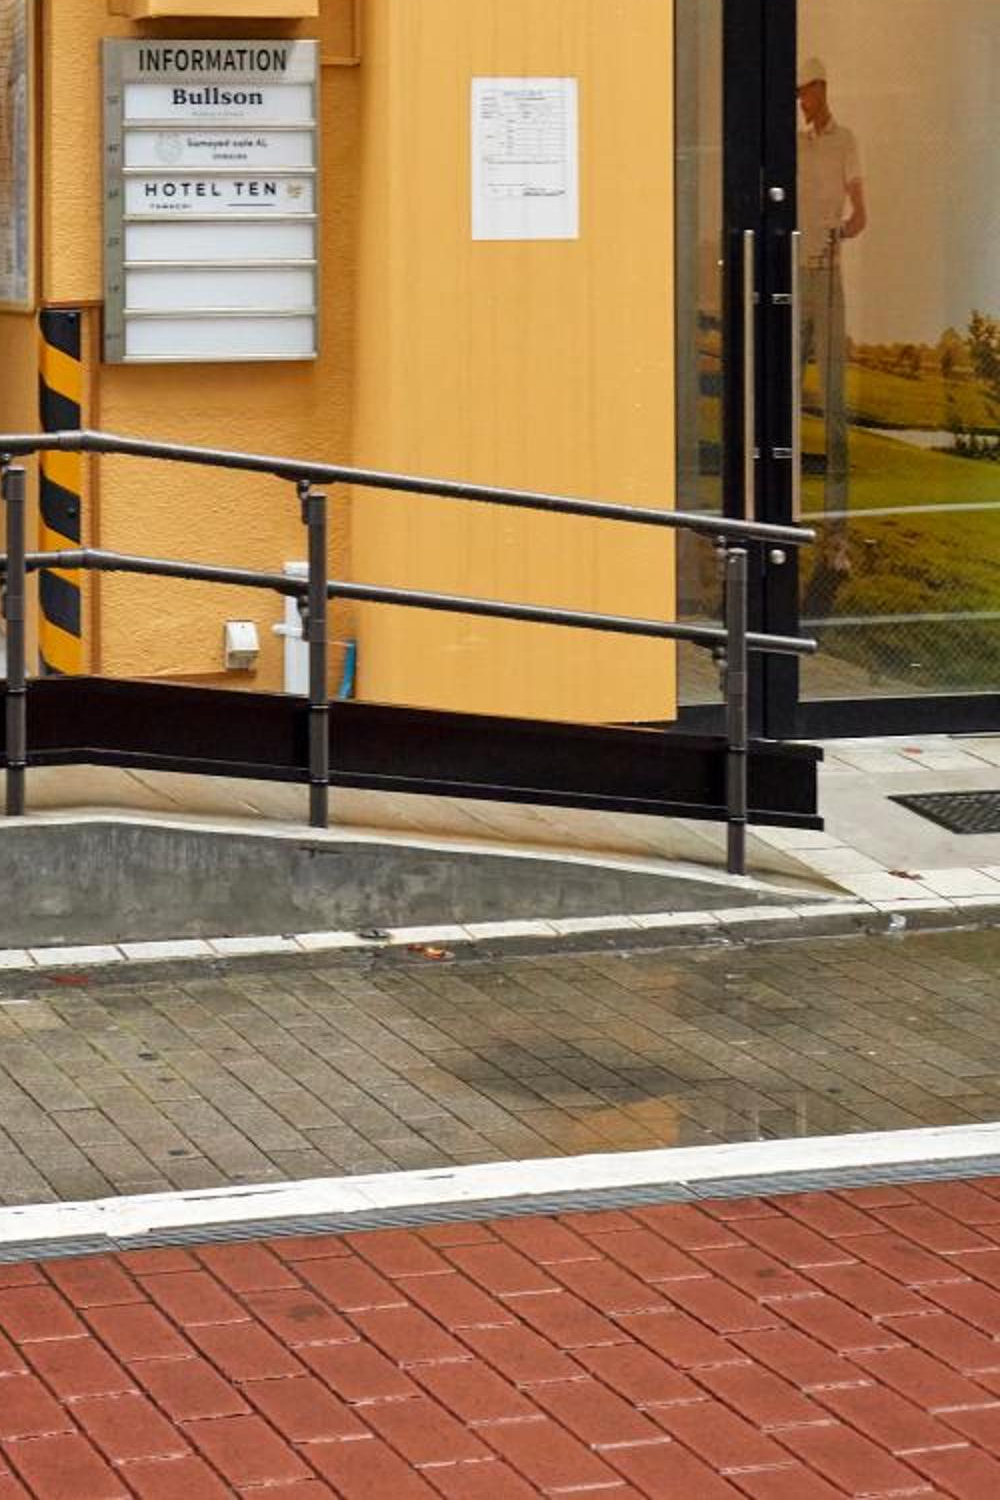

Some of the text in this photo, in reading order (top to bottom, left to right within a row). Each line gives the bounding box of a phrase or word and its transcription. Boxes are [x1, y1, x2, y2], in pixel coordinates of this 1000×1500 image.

[138, 49, 287, 72] INFORMATION
[172, 87, 263, 105] Bullson
[145, 181, 277, 197] HOTEL TEN
